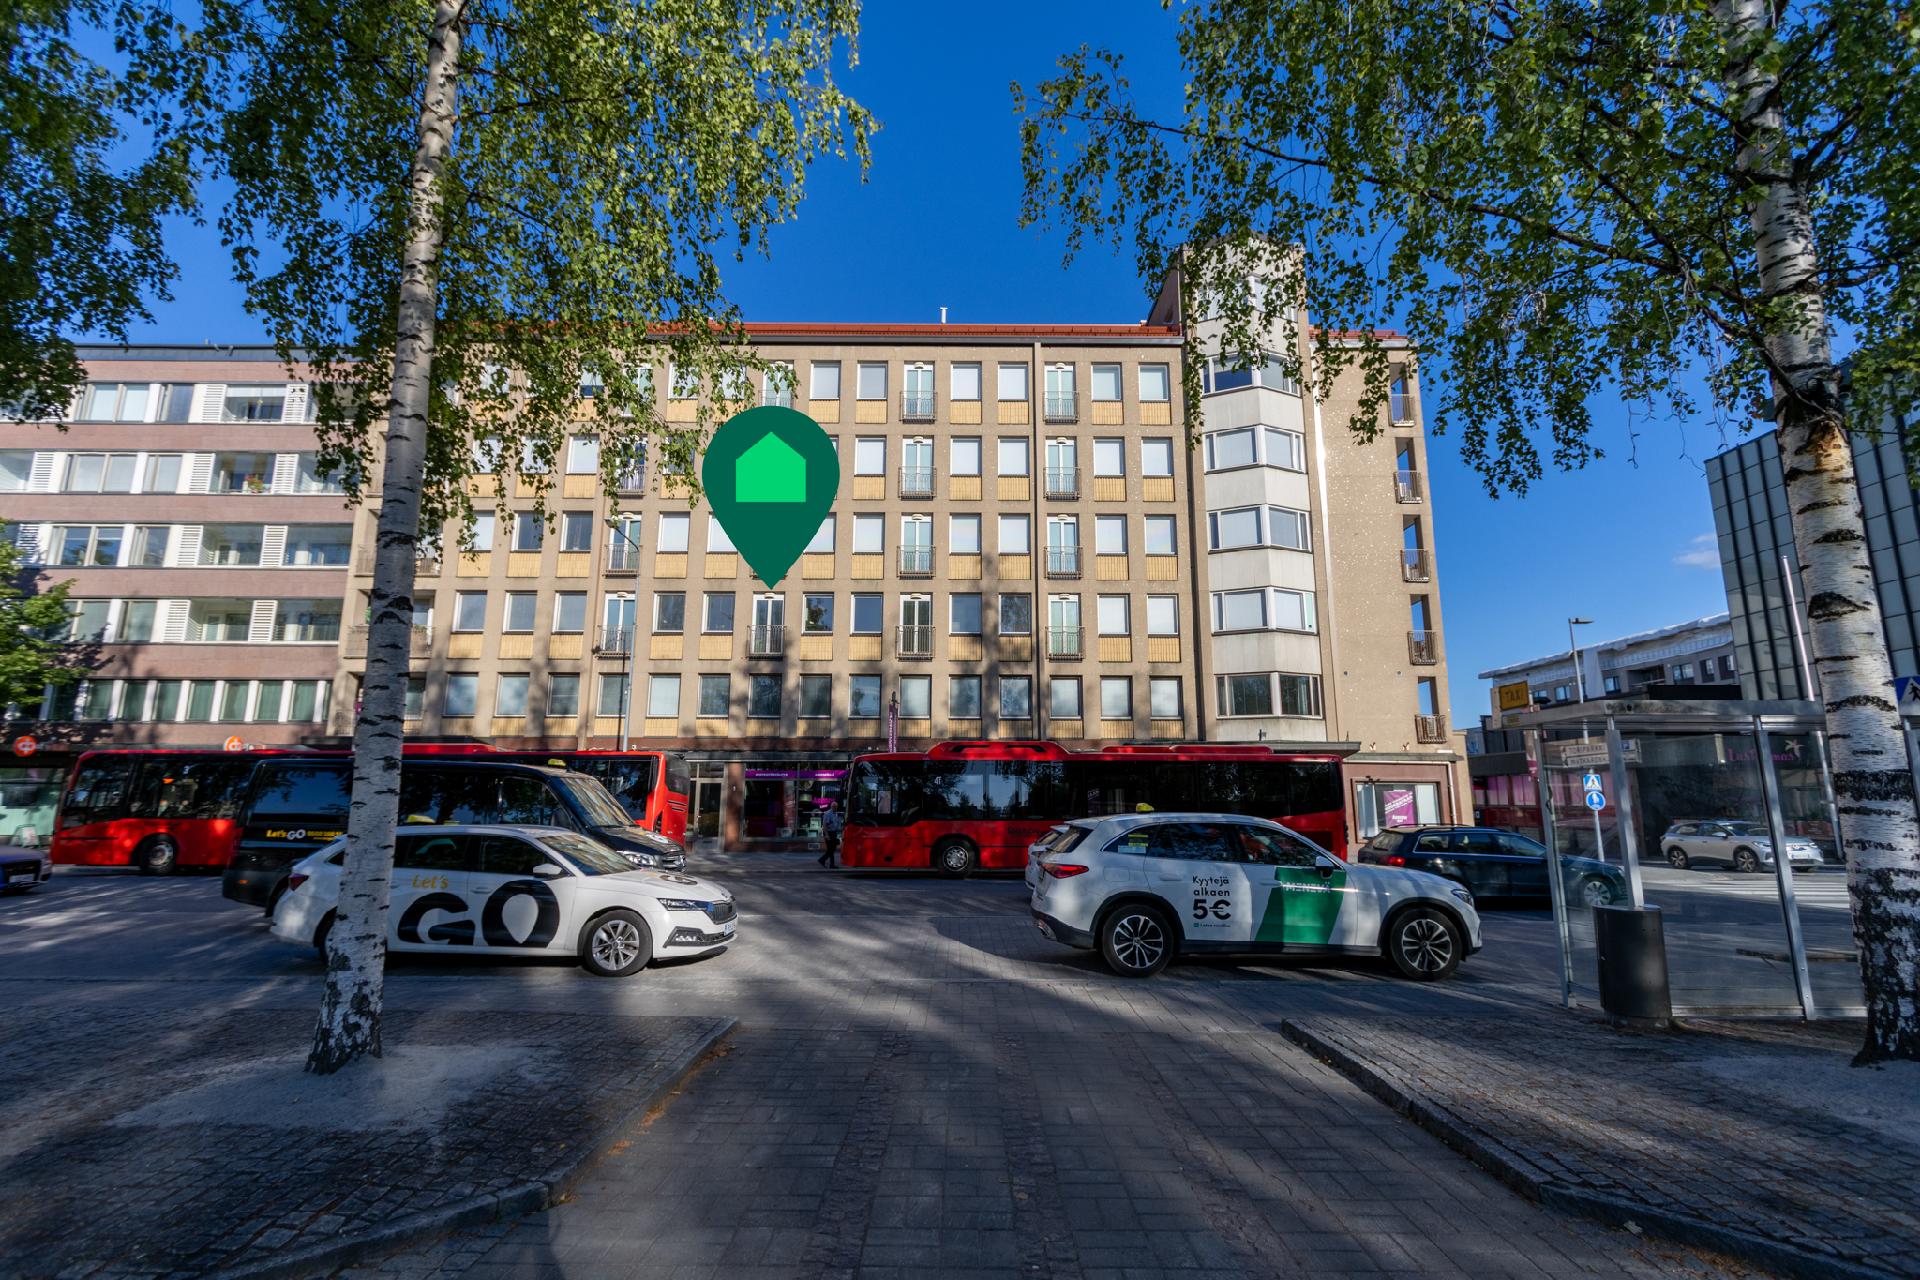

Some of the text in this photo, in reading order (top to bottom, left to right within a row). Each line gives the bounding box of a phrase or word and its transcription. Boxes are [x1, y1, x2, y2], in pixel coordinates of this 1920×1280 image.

[266, 829, 287, 838] Let's
[287, 828, 306, 840] GO
[411, 872, 449, 889] Let's
[1192, 875, 1230, 887] Kyytejä
[1193, 887, 1230, 897] alkaen
[397, 879, 560, 948] GO
[1192, 899, 1231, 920] 5€
